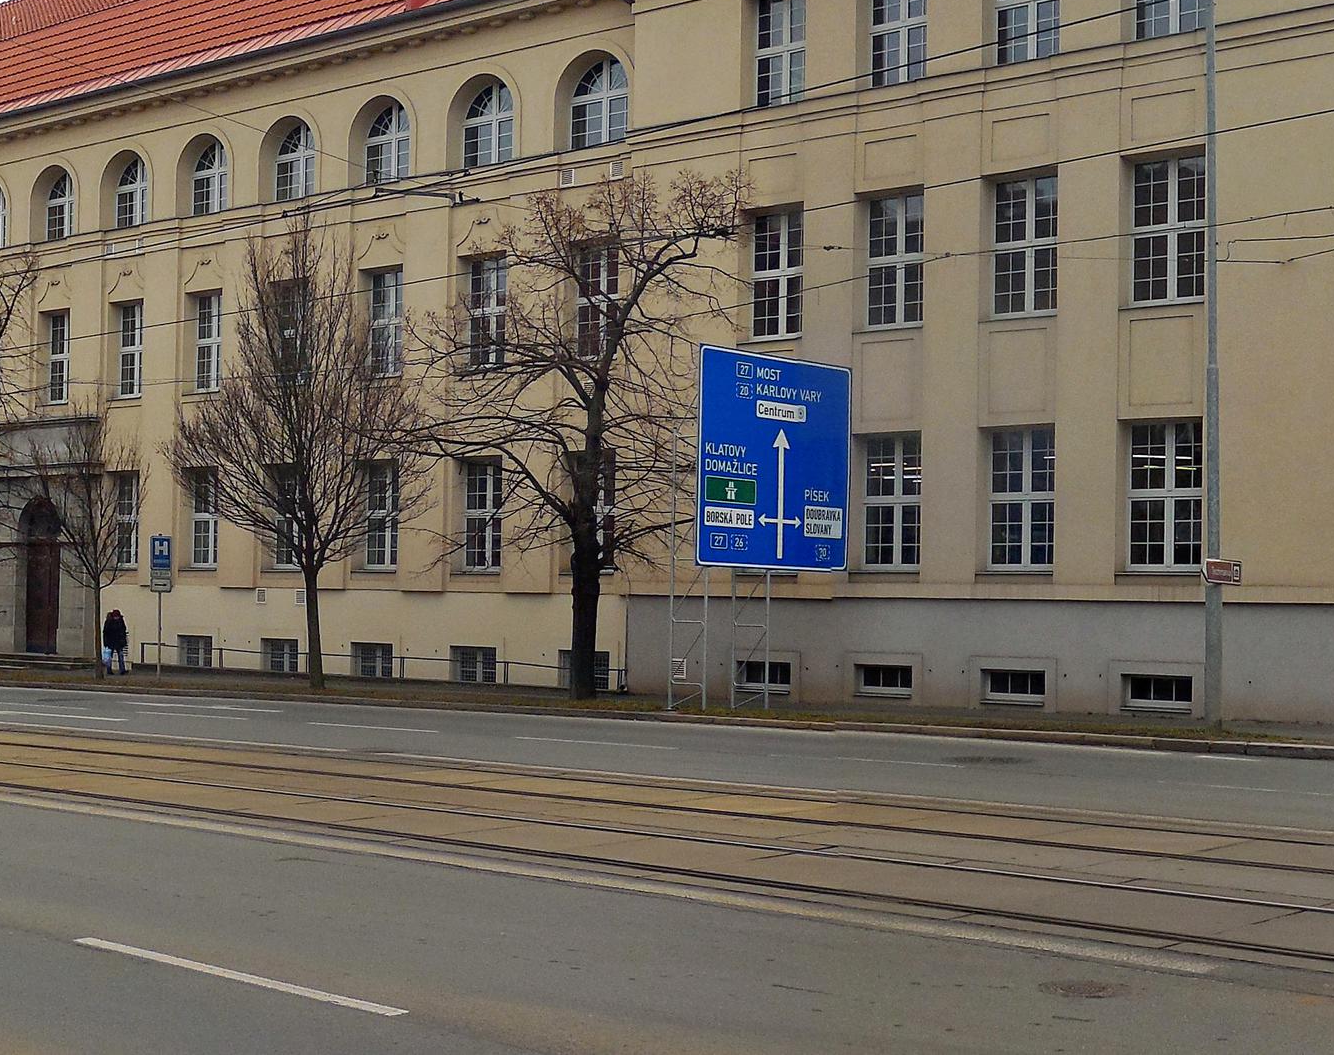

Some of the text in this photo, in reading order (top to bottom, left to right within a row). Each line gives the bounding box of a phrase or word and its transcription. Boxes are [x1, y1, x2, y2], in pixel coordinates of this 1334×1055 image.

[740, 365, 781, 381] 27 MOST
[739, 383, 822, 403] 20 KARLOVY VARY
[758, 403, 795, 419] Centrum
[705, 441, 747, 458] KLATOVY
[705, 458, 758, 476] DOMAŽLICE
[804, 487, 830, 502] PÍSEK
[706, 509, 753, 526] BORSKÁ POLE
[805, 508, 841, 522] DOUBRAVKA
[805, 523, 833, 536] SLOVANY
[154, 540, 169, 555] H
[714, 535, 724, 546] 27
[734, 537, 744, 547] 26
